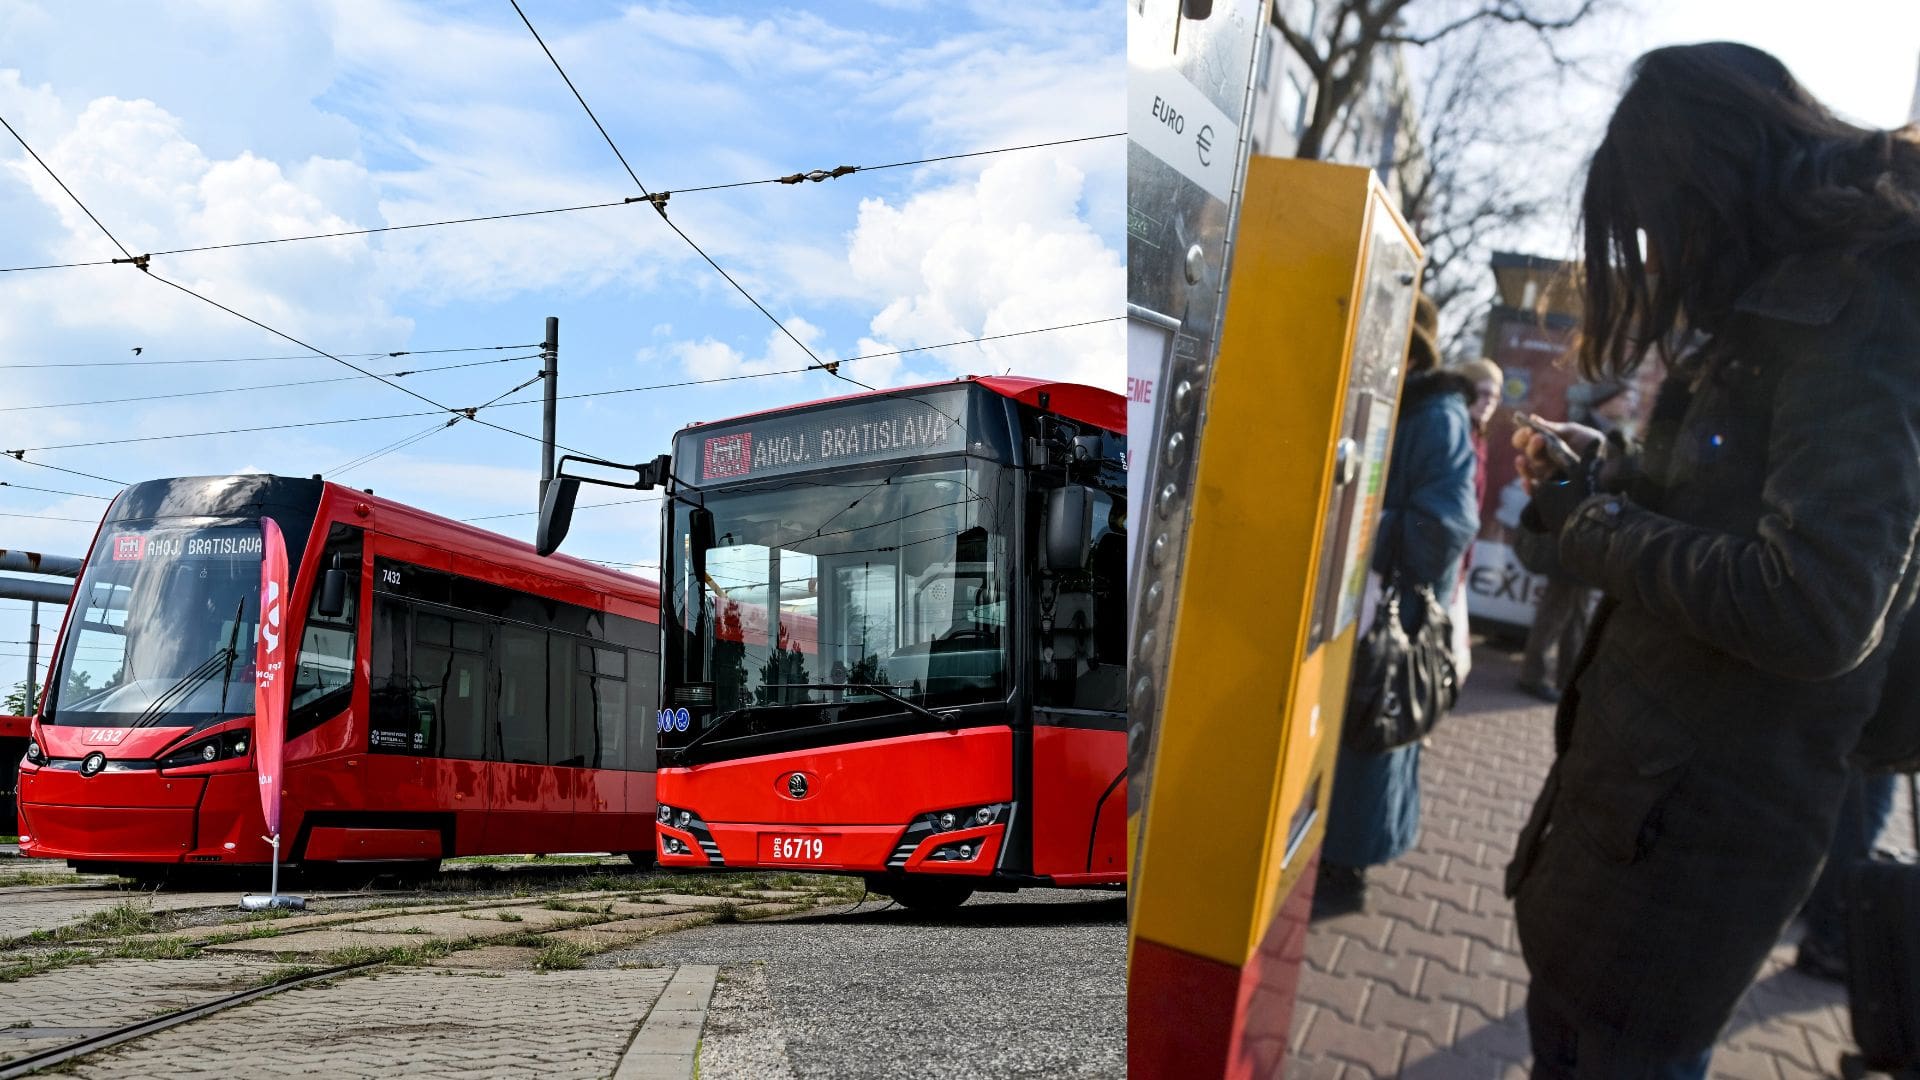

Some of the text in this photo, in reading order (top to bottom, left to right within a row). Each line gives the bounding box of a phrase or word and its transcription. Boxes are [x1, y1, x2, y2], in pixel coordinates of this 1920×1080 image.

[1152, 95, 1184, 135] EURO
[821, 411, 949, 458] BRATISLAVA
[188, 537, 263, 555] BRATISLAVA
[382, 569, 400, 585] 7432
[89, 729, 122, 742] 7432
[773, 837, 823, 859] DPB 6719
